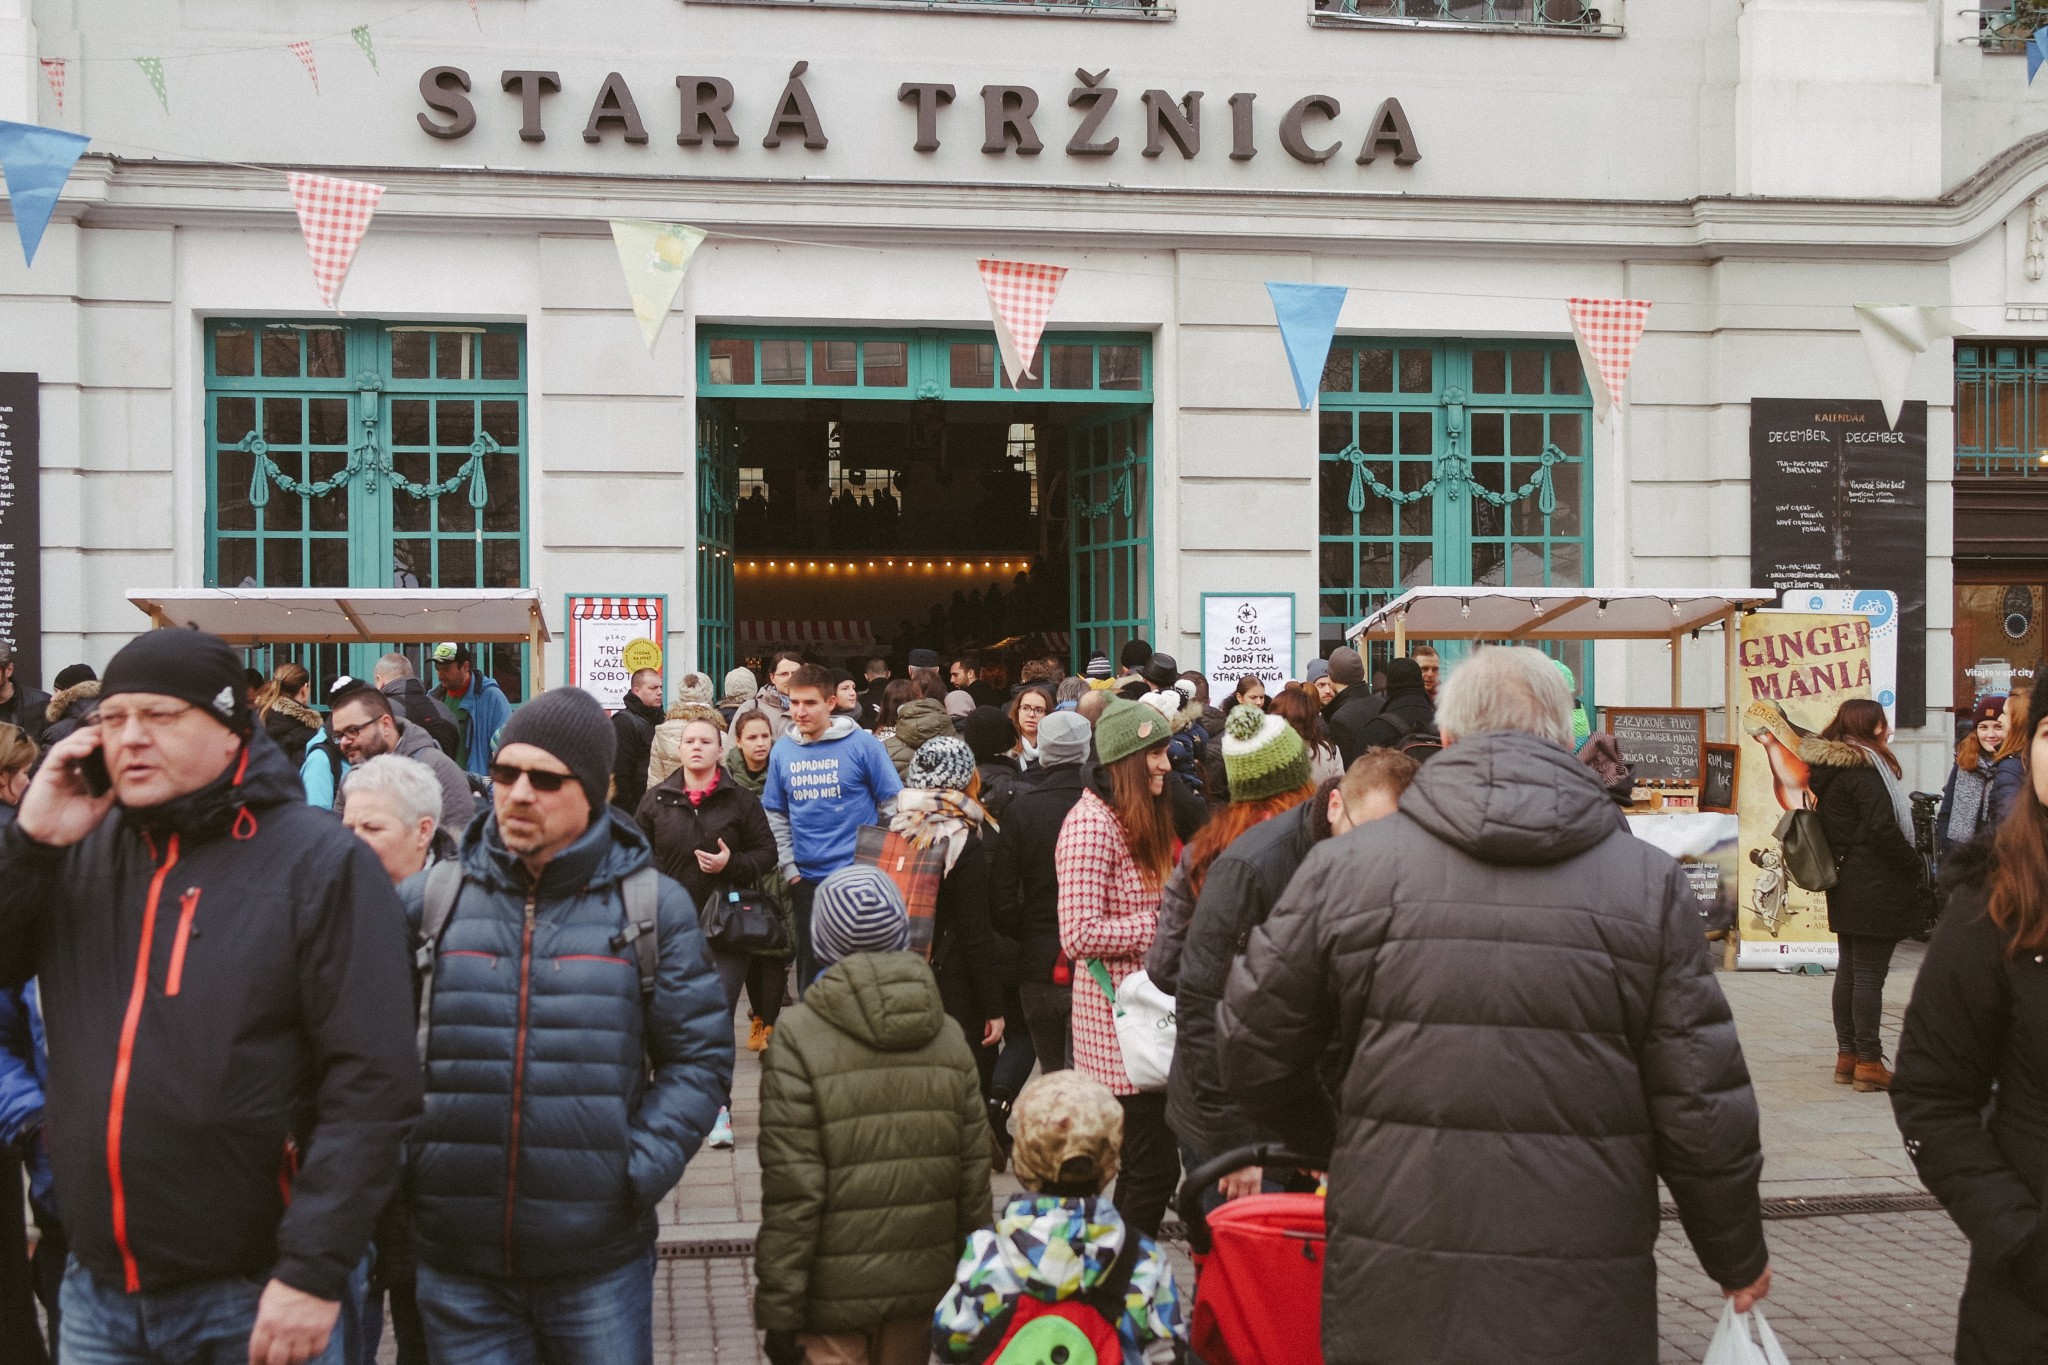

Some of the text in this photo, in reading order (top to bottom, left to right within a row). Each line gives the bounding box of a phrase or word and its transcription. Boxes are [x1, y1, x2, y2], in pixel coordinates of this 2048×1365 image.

[417, 61, 1421, 166] STARÁ TRŽNICA
[1768, 429, 1830, 443] DECEMBER
[1845, 431, 1906, 443] DECEMBER
[599, 645, 625, 655] TRH
[1739, 620, 1871, 668] GINGER
[1223, 652, 1274, 664] DOBRÝ TRH
[1213, 671, 1240, 682] STARÁ
[1748, 658, 1872, 701] MANIA
[1964, 668, 1994, 678] Vitajte
[2002, 668, 2016, 679] up!
[2017, 668, 2035, 679] city
[603, 686, 628, 694] MARKT
[1669, 717, 1691, 730] PIVO
[1643, 732, 1672, 743] GINGER
[1672, 734, 1697, 744] MANIA
[789, 758, 839, 774] ODPADNEM
[1681, 757, 1699, 768] RUM
[1708, 753, 1722, 768] RUM
[791, 770, 839, 787] ODPADNEŠ
[793, 784, 842, 801] ODPAD NIE!
